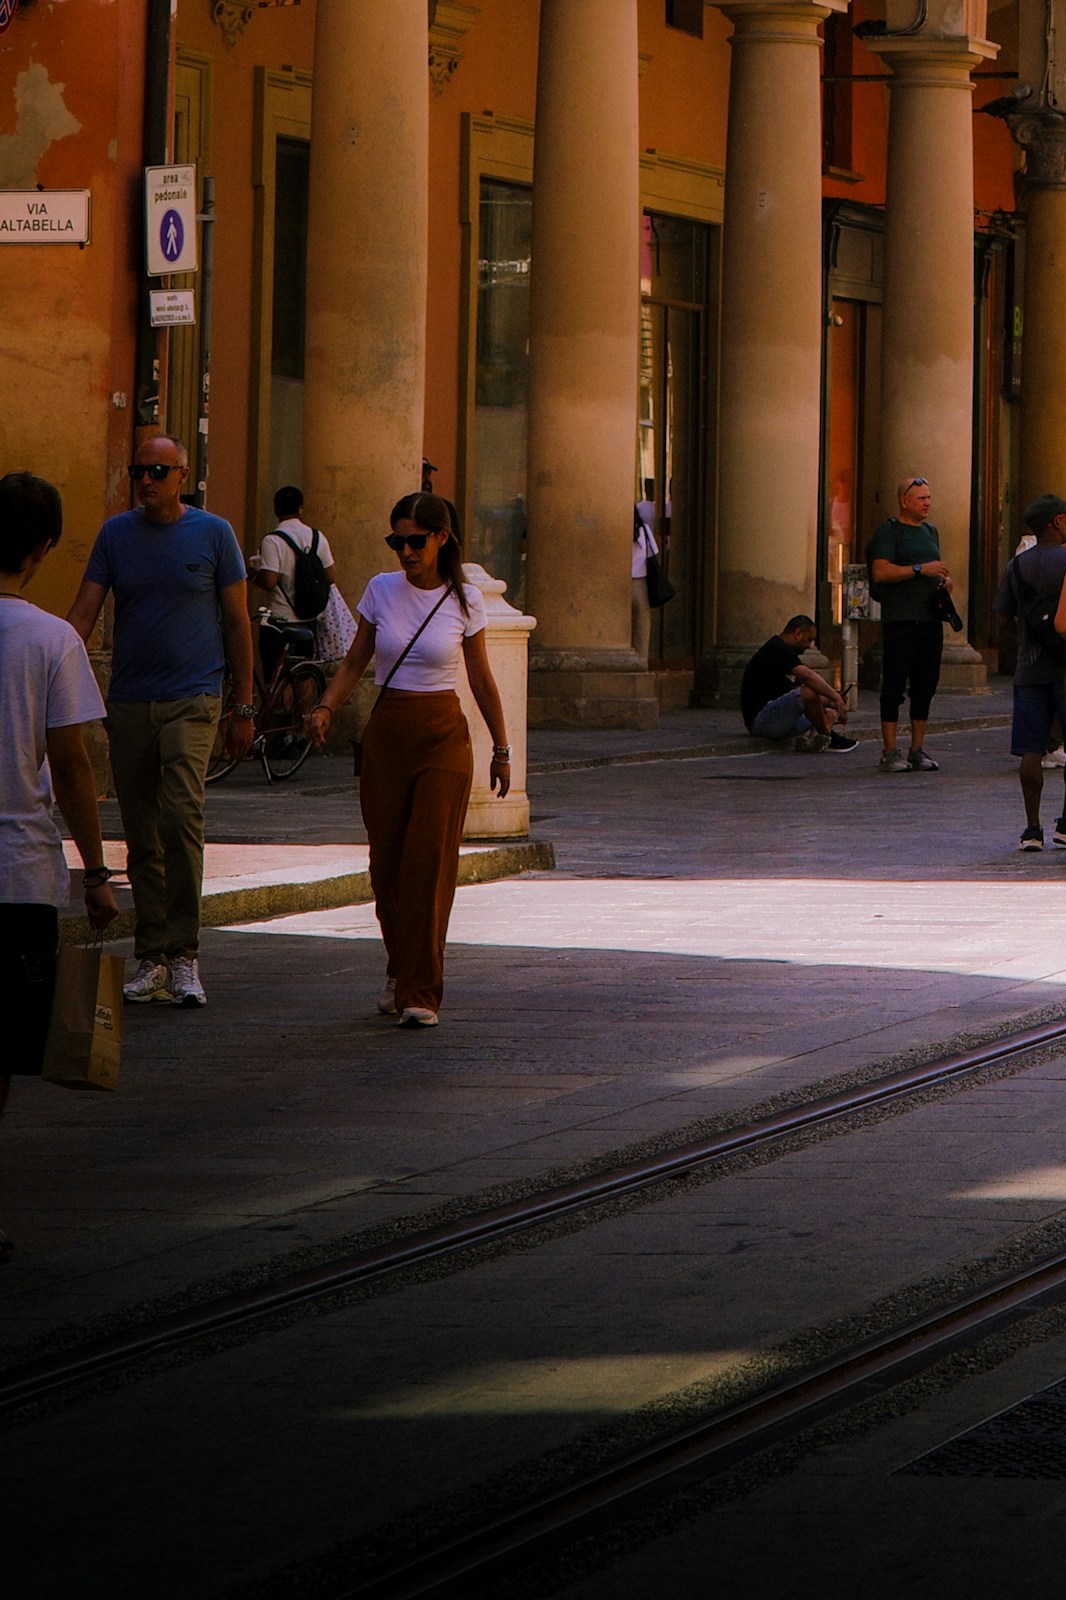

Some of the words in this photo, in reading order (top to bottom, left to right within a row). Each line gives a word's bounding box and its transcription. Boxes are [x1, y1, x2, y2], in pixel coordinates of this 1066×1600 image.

[163, 174, 178, 184] area
[154, 189, 187, 204] pedonale
[27, 203, 48, 215] VIA
[0, 219, 74, 231] ALTABELLA
